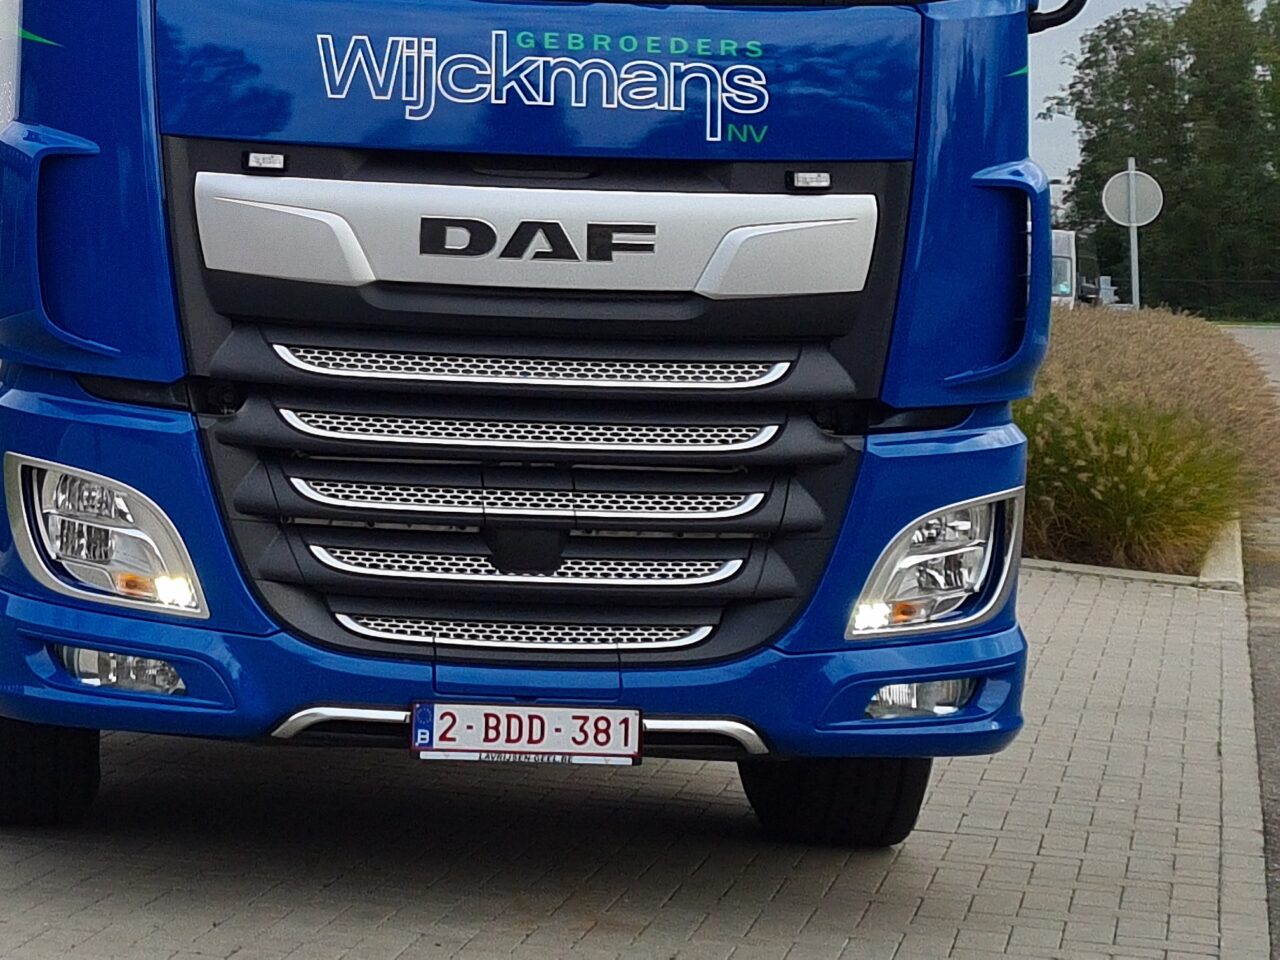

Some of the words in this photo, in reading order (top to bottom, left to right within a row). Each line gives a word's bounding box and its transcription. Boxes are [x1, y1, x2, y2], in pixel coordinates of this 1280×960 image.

[516, 31, 763, 57] GEBROEDERS
[317, 30, 769, 142] Wijckmans
[727, 123, 767, 143] NV
[419, 217, 656, 262] DAF
[417, 728, 430, 744] B
